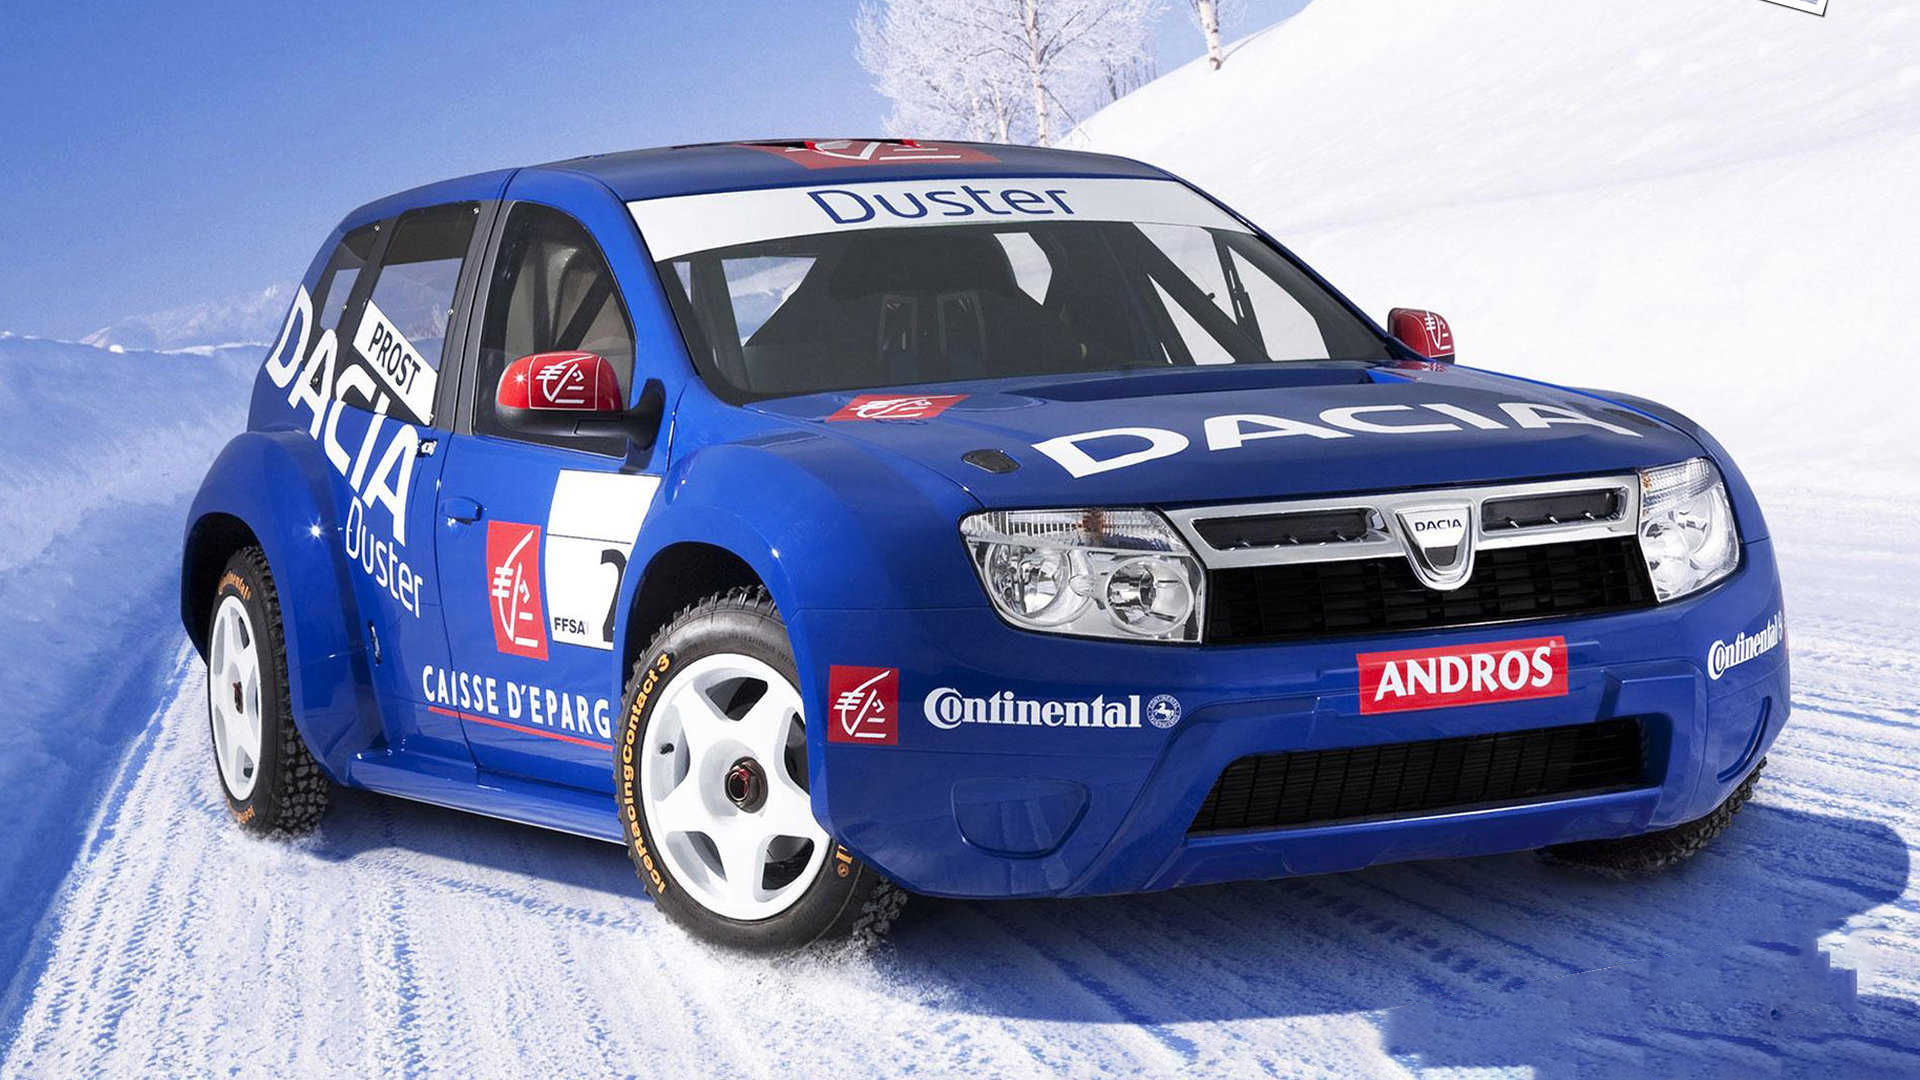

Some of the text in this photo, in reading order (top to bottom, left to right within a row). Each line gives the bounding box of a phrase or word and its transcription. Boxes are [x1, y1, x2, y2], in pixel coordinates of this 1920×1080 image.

[807, 185, 1074, 225] Duster
[368, 321, 421, 395] PROST
[265, 284, 418, 547] DACIA
[1032, 402, 1643, 479] DACIA
[1414, 518, 1462, 533] DACIA
[346, 496, 423, 618] Duster
[553, 616, 586, 635] FFSA
[1707, 613, 1779, 681] Continental
[422, 664, 500, 715] CAISSE
[1374, 645, 1553, 702] ANDROS
[924, 686, 1142, 730] Continental
[622, 653, 671, 894] IceRacingContact 3
